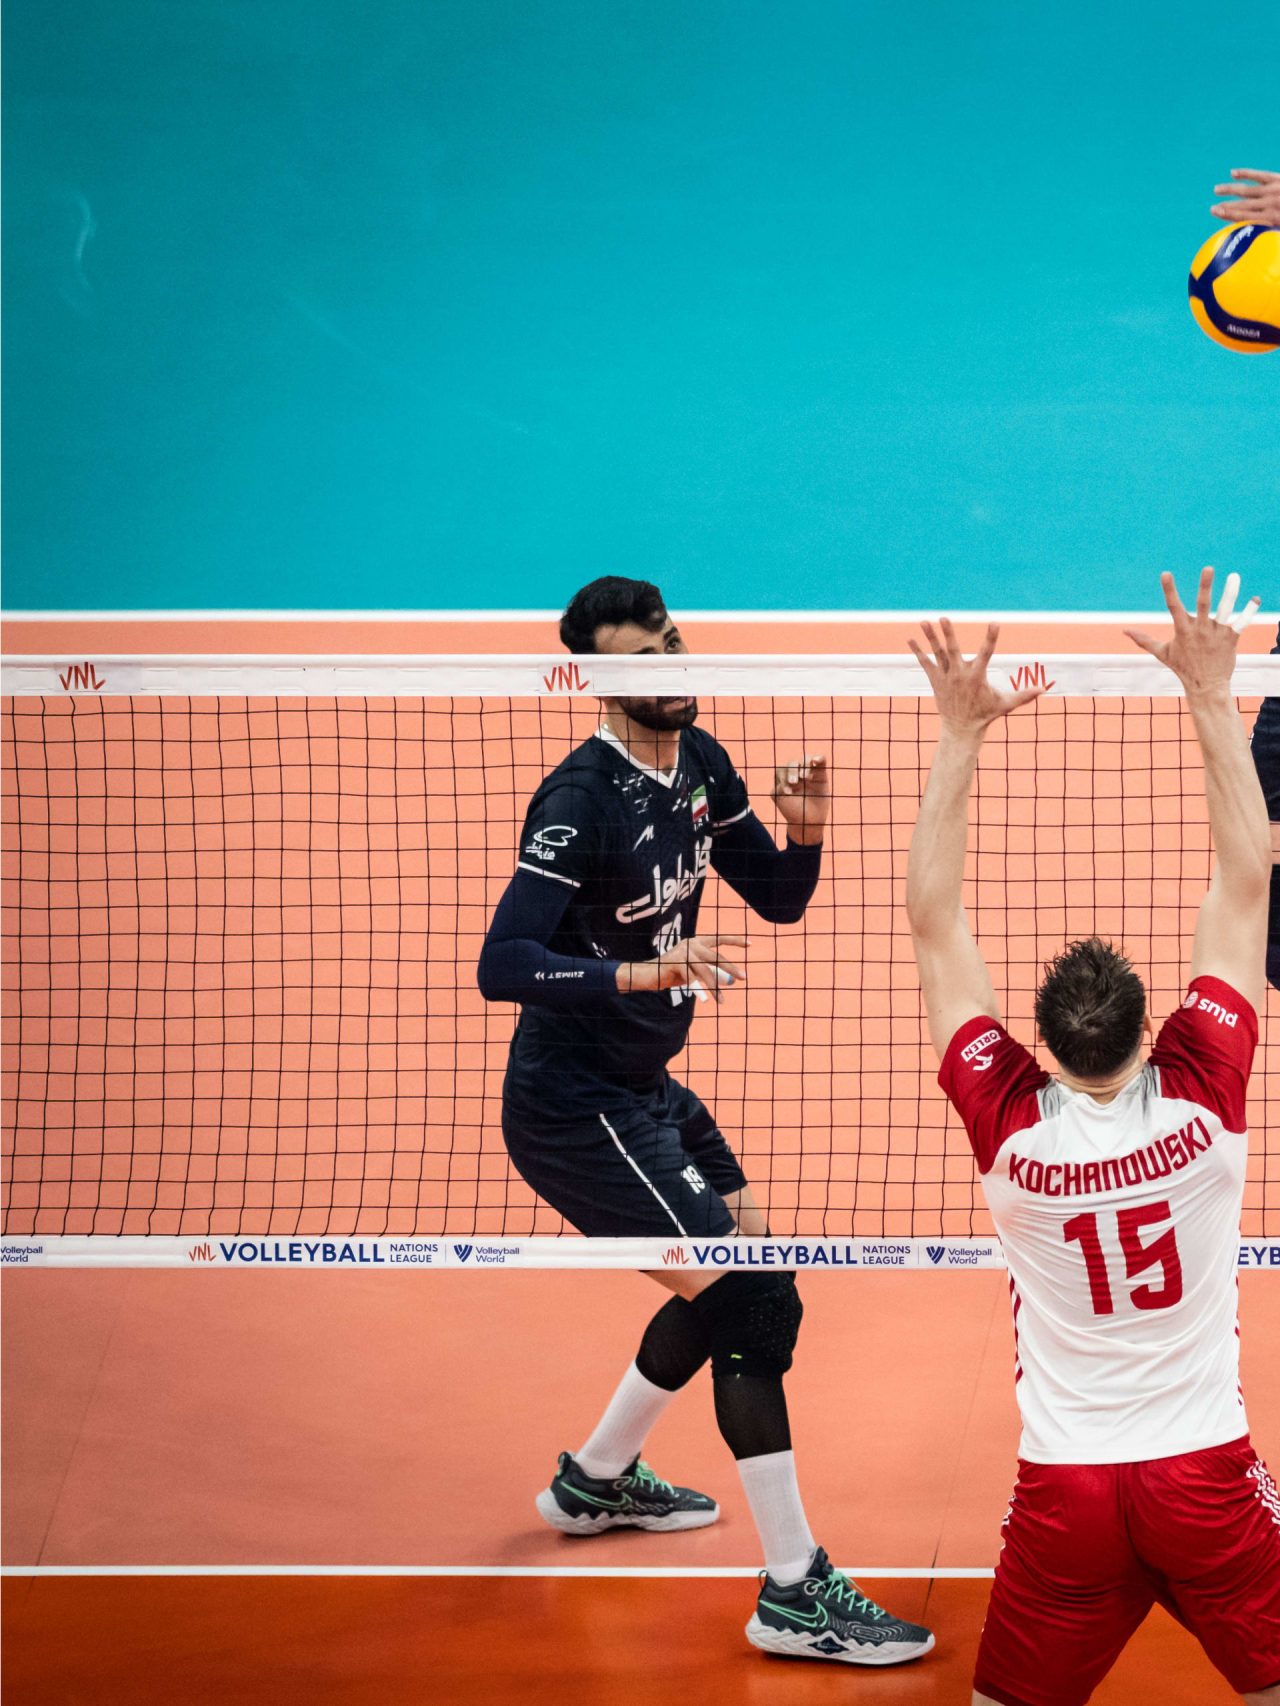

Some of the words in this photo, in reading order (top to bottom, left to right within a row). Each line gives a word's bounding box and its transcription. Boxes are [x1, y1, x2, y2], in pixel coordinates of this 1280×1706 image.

[60, 661, 106, 691] VNL
[543, 661, 589, 692] VNL
[1009, 661, 1056, 691] VNL
[1198, 998, 1239, 1028] plus
[963, 1031, 998, 1059] ORLEN
[1008, 1116, 1213, 1197] KOCHANOWSKI
[189, 1242, 217, 1262] VNL
[219, 1242, 386, 1262] VOLLEYBALL
[390, 1243, 439, 1252] NATIONS
[475, 1246, 520, 1256] Volleyball
[662, 1245, 690, 1265] VNL
[692, 1245, 858, 1265] VOLLEYBALL
[862, 1245, 912, 1254] NATIONS
[948, 1248, 992, 1257] Volleyball
[1063, 1200, 1183, 1315] 15
[390, 1254, 433, 1263] LEAGUE
[475, 1255, 505, 1263] World
[862, 1256, 905, 1265] LEAGUE
[948, 1256, 978, 1265] World
